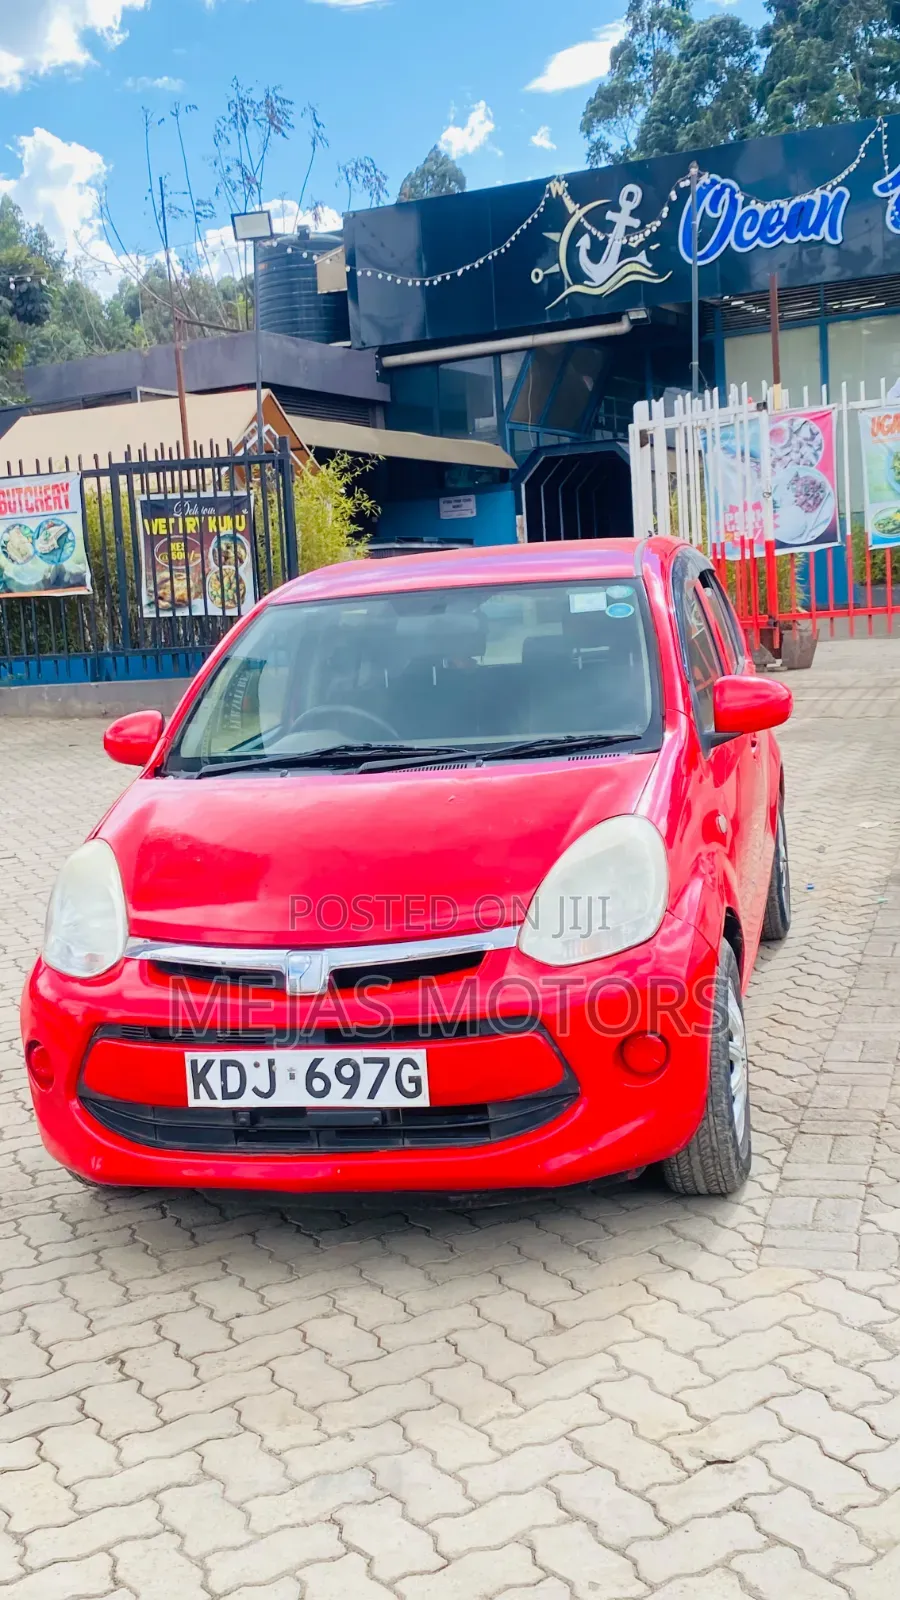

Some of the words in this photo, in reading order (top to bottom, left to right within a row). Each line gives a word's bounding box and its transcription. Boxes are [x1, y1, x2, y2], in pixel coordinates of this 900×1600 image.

[678, 174, 851, 266] Ocean
[0, 482, 70, 516] BUTCHERY
[143, 517, 175, 536] WET
[190, 1058, 277, 1100] KDJ
[305, 1057, 423, 1100] 697G
